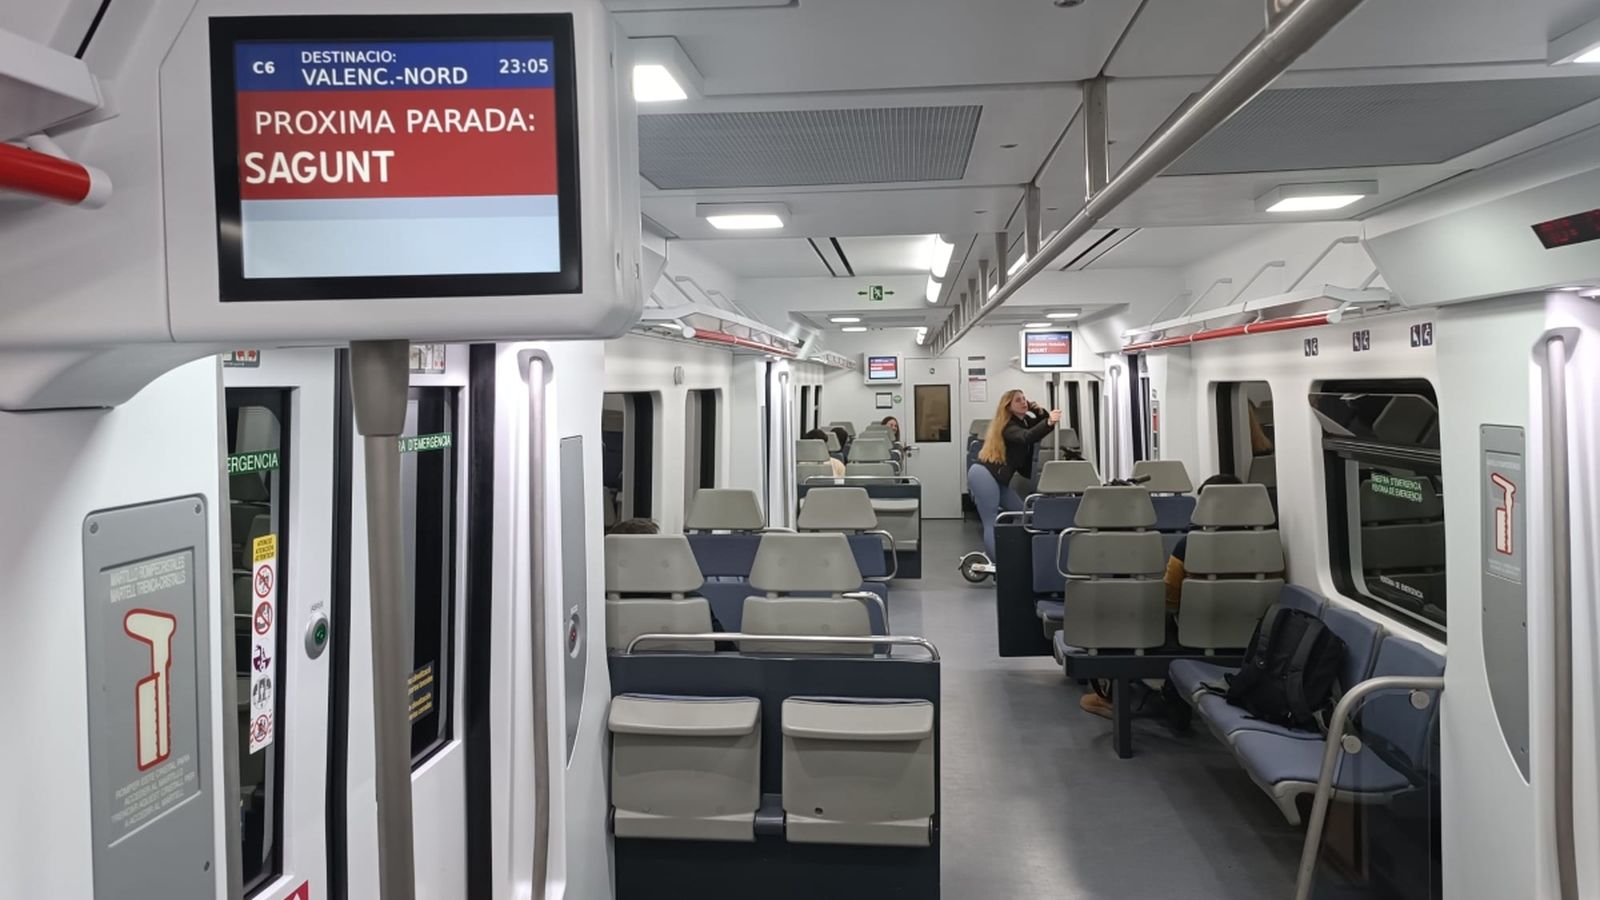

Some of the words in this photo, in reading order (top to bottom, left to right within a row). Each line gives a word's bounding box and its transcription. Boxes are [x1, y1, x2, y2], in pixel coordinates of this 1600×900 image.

[301, 50, 397, 64] DESTINACIO:
[499, 58, 549, 74] 23:05
[252, 60, 275, 74] C6
[301, 66, 468, 86] VALENC.-NORD
[255, 109, 396, 135] PROXIMA
[406, 107, 535, 134] PARADA:
[244, 150, 395, 184] SAGUNT
